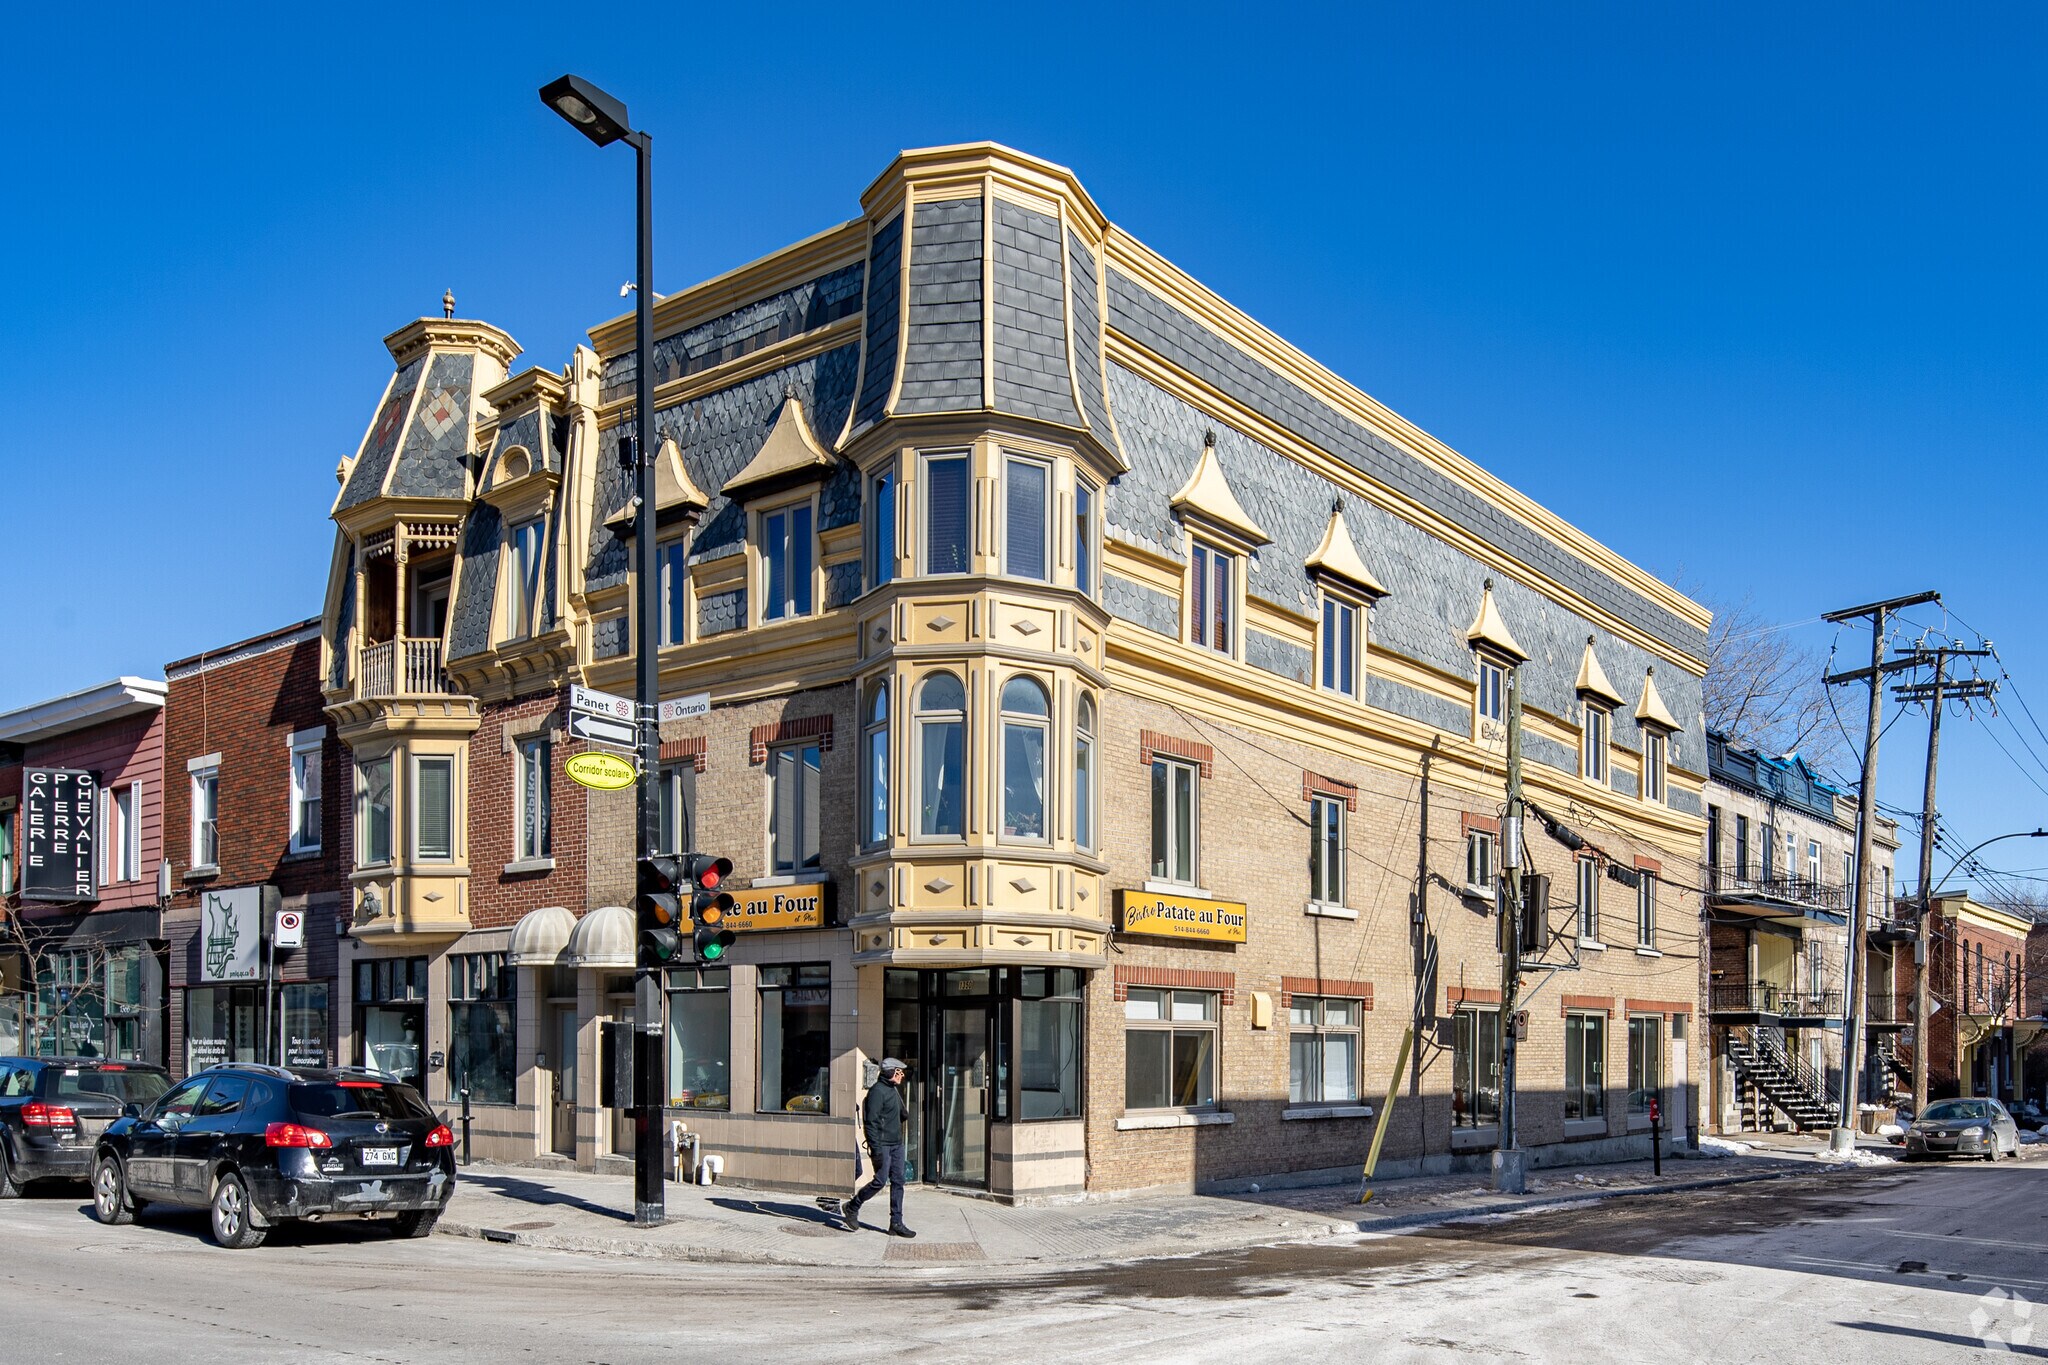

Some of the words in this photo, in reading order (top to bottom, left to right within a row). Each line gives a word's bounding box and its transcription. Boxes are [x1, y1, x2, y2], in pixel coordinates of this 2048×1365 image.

[577, 694, 609, 712] Panet
[675, 701, 706, 716] Ontario
[573, 762, 603, 776] Corridor
[604, 765, 630, 779] scolaire
[29, 772, 47, 867] GALERIE
[54, 773, 70, 854] PIERRE
[76, 774, 93, 896] CHEVALIER
[747, 901, 767, 915] au
[773, 894, 818, 914] Four
[1125, 905, 1156, 927] Bistro
[1156, 901, 1196, 922] Patate
[1199, 911, 1213, 923] au
[1216, 908, 1244, 926] Four
[365, 1151, 378, 1161] Z74
[382, 1151, 396, 1161] GXC
